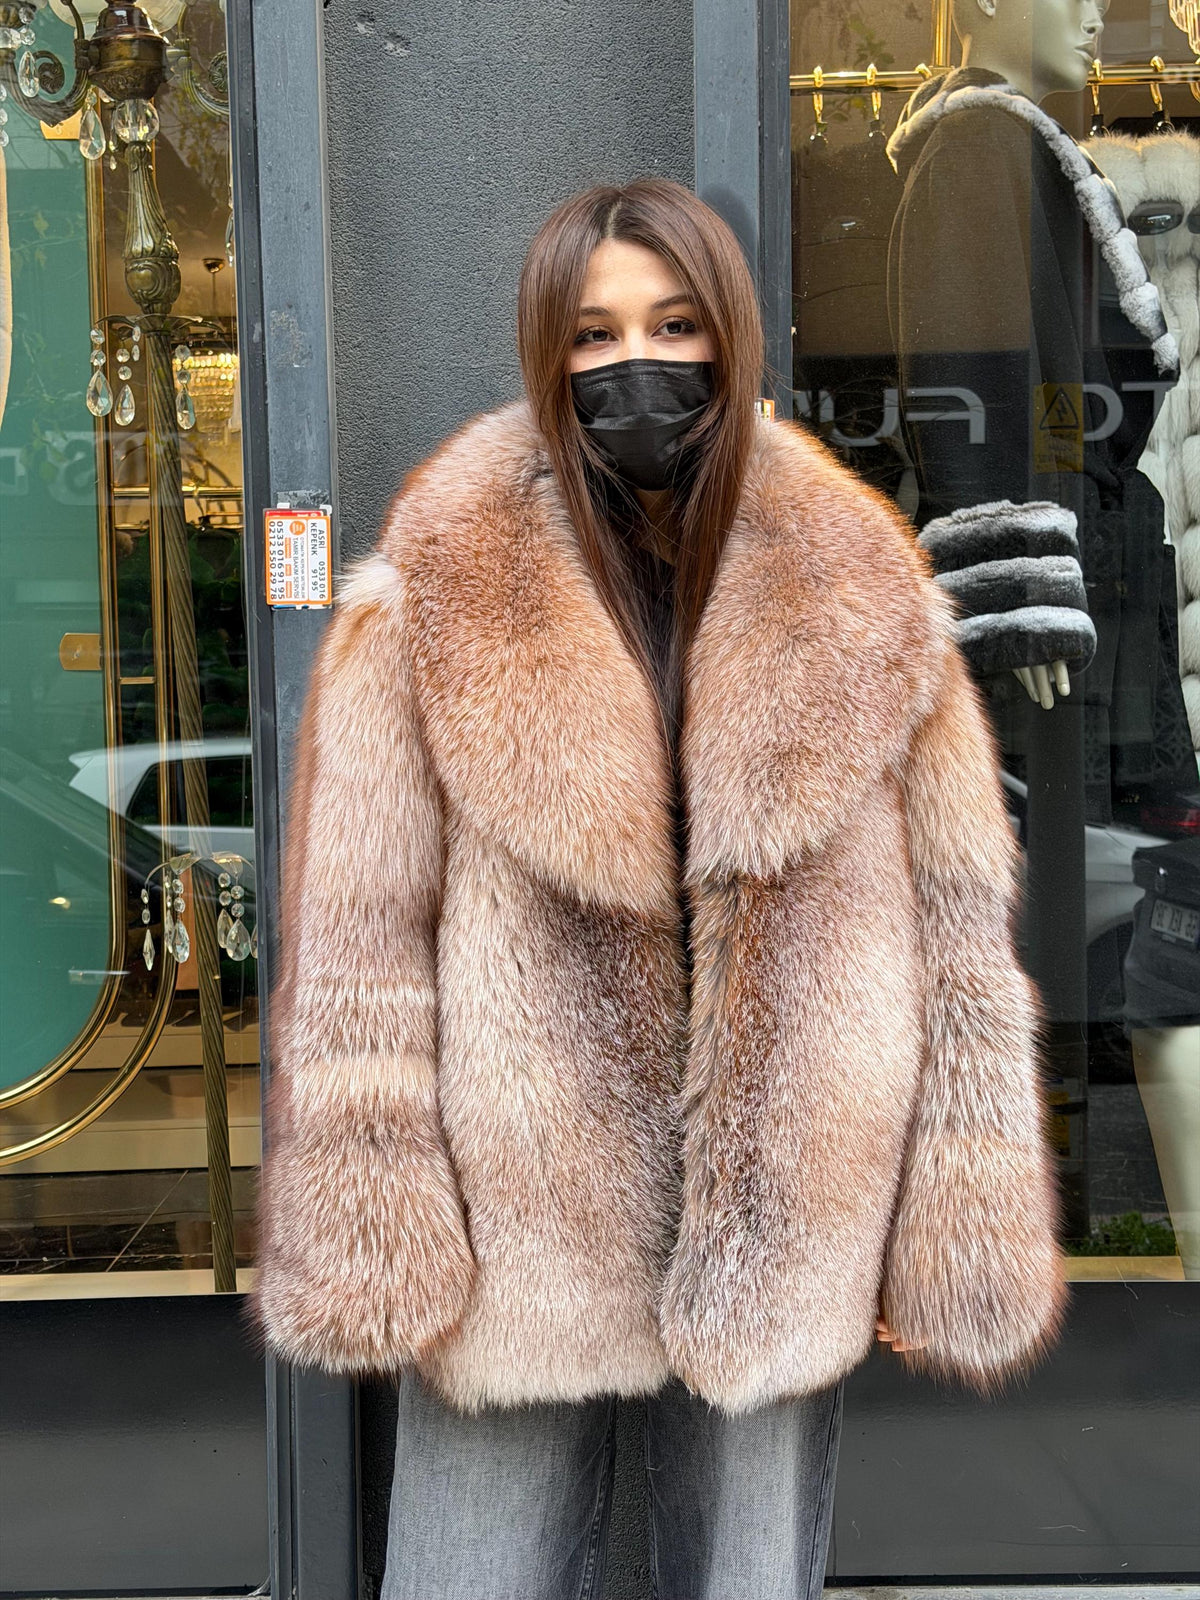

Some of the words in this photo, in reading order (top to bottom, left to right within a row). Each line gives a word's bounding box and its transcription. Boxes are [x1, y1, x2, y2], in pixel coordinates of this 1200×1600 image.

[318, 530, 326, 549] ASRİ
[270, 572, 277, 584] 29
[278, 572, 284, 583] 91
[311, 569, 318, 578] 91
[312, 581, 318, 591] 95
[270, 587, 277, 599] 78
[278, 587, 285, 599] 95
